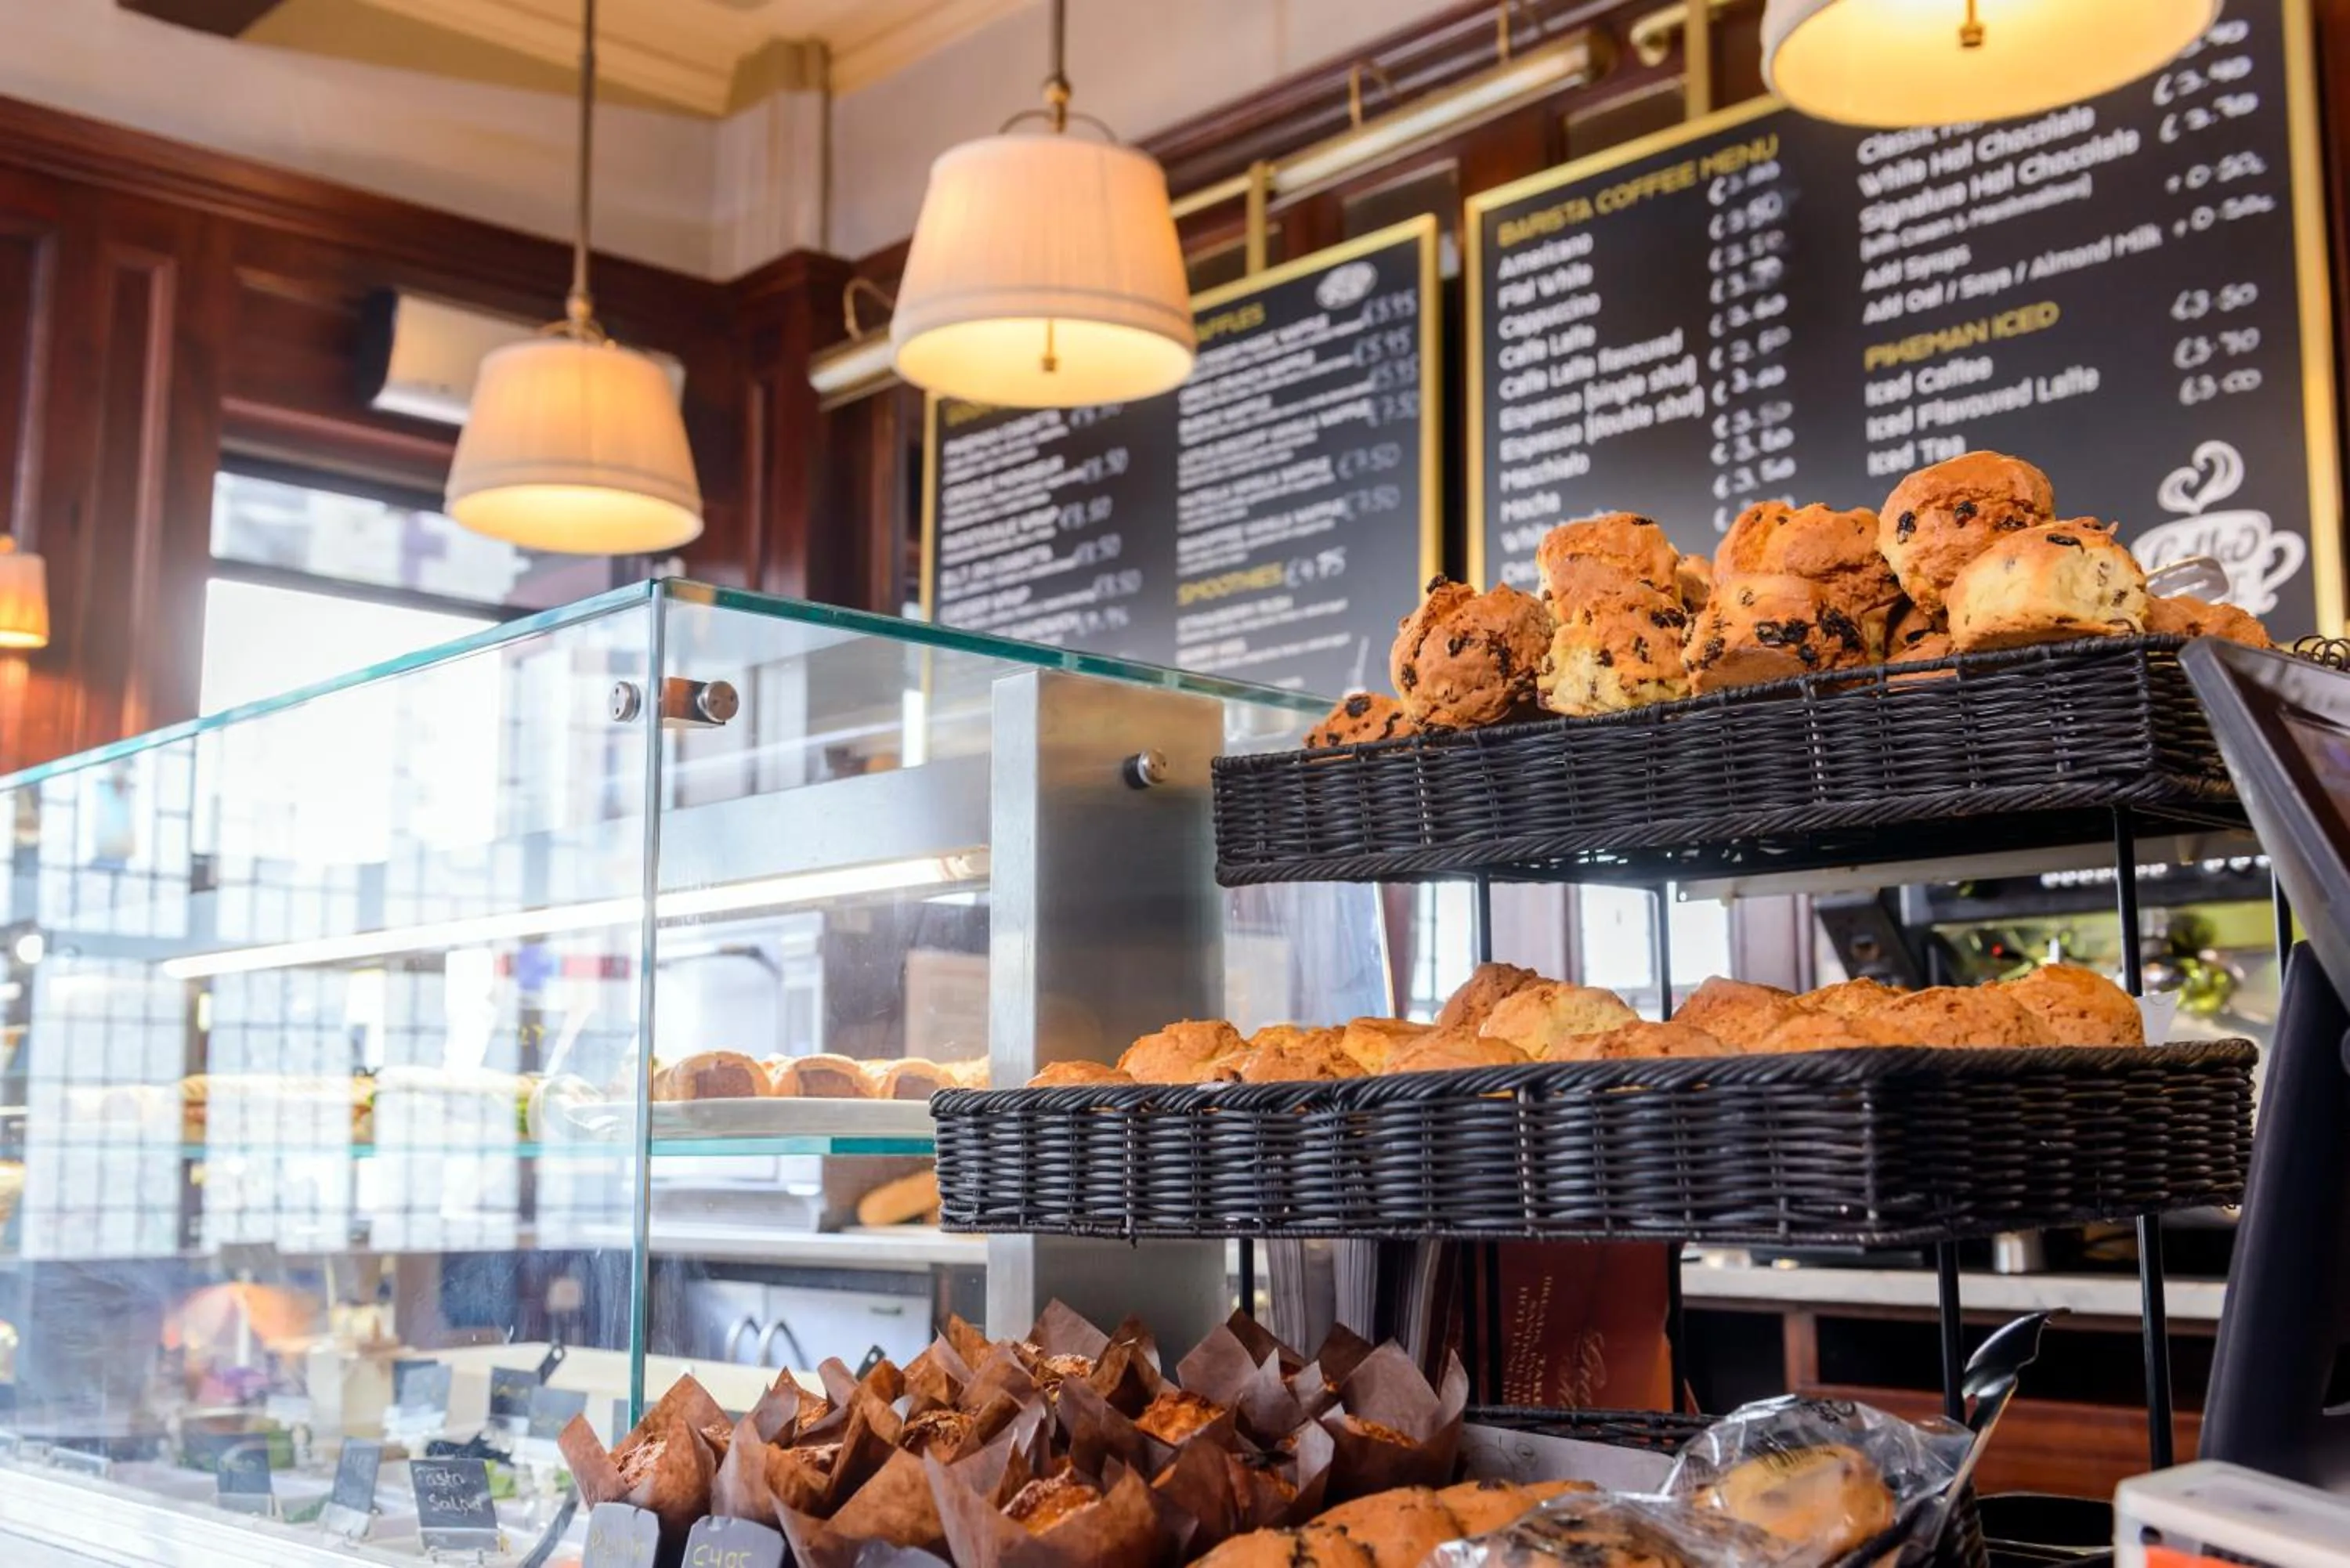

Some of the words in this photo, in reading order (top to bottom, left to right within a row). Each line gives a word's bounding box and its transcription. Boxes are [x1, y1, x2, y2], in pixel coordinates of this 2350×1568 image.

[1858, 158, 1927, 197] White
[1930, 140, 1973, 176] Hot
[1976, 107, 2095, 162] Chocolate
[1497, 197, 1593, 247] BARISTA
[1595, 160, 1696, 215] COFFEE
[1699, 133, 1780, 180] MENU
[1860, 182, 1967, 233] Signature
[1970, 162, 2014, 199] Hot
[2018, 128, 2140, 185] Chocolate
[1498, 233, 1593, 280] Americano
[1862, 260, 1903, 291] Add
[1864, 292, 1904, 324] Add
[2029, 237, 2112, 279] Almond
[2114, 225, 2162, 255] Milk
[1498, 279, 1536, 309] Flat
[1537, 263, 1593, 297] White
[1196, 302, 1265, 342] AFFLES
[1498, 293, 1601, 340] Cappuccino
[1864, 319, 1988, 370] PIKEMAN
[1990, 301, 2060, 338] ICED
[1549, 324, 1596, 356] Latte
[1549, 356, 1596, 387] Latte
[1866, 370, 1913, 406] Iced
[1916, 356, 1994, 394] Coffee
[1499, 392, 1583, 431] Espresso
[1867, 406, 1914, 441] Iced
[1917, 378, 2034, 430] Flavoured
[2036, 366, 2099, 403] Latte
[1499, 423, 1584, 462] Espresso
[1867, 441, 1915, 476] Iced
[1500, 491, 1561, 523] Mocha
[1177, 561, 1284, 607] SMOOTHIES
